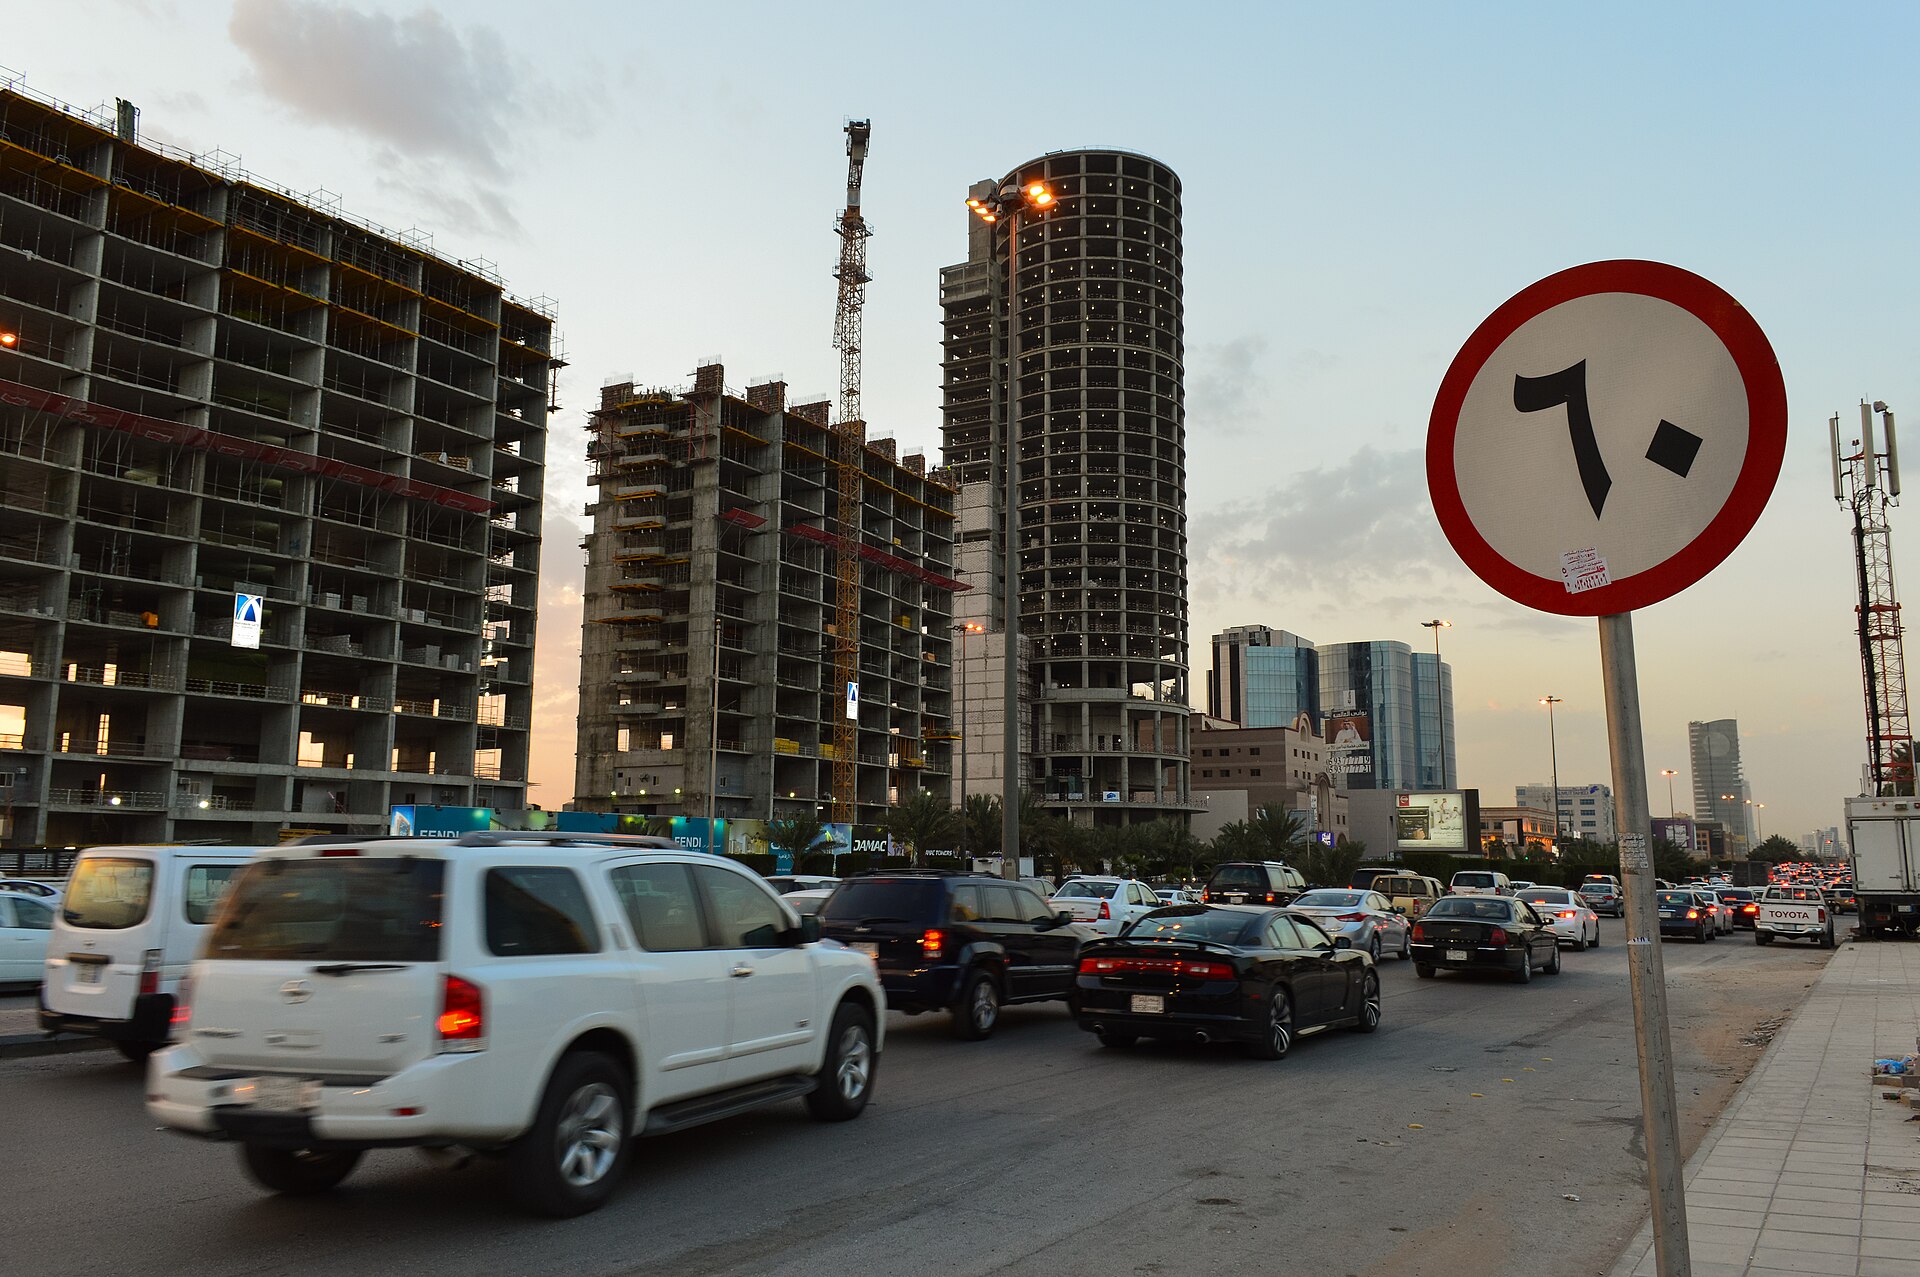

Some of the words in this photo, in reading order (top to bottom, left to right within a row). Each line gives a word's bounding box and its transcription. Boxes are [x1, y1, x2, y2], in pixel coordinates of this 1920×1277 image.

[1514, 358, 1704, 521] ٦٠
[674, 836, 702, 848] FENDI
[1769, 910, 1809, 919] TOYOTA
